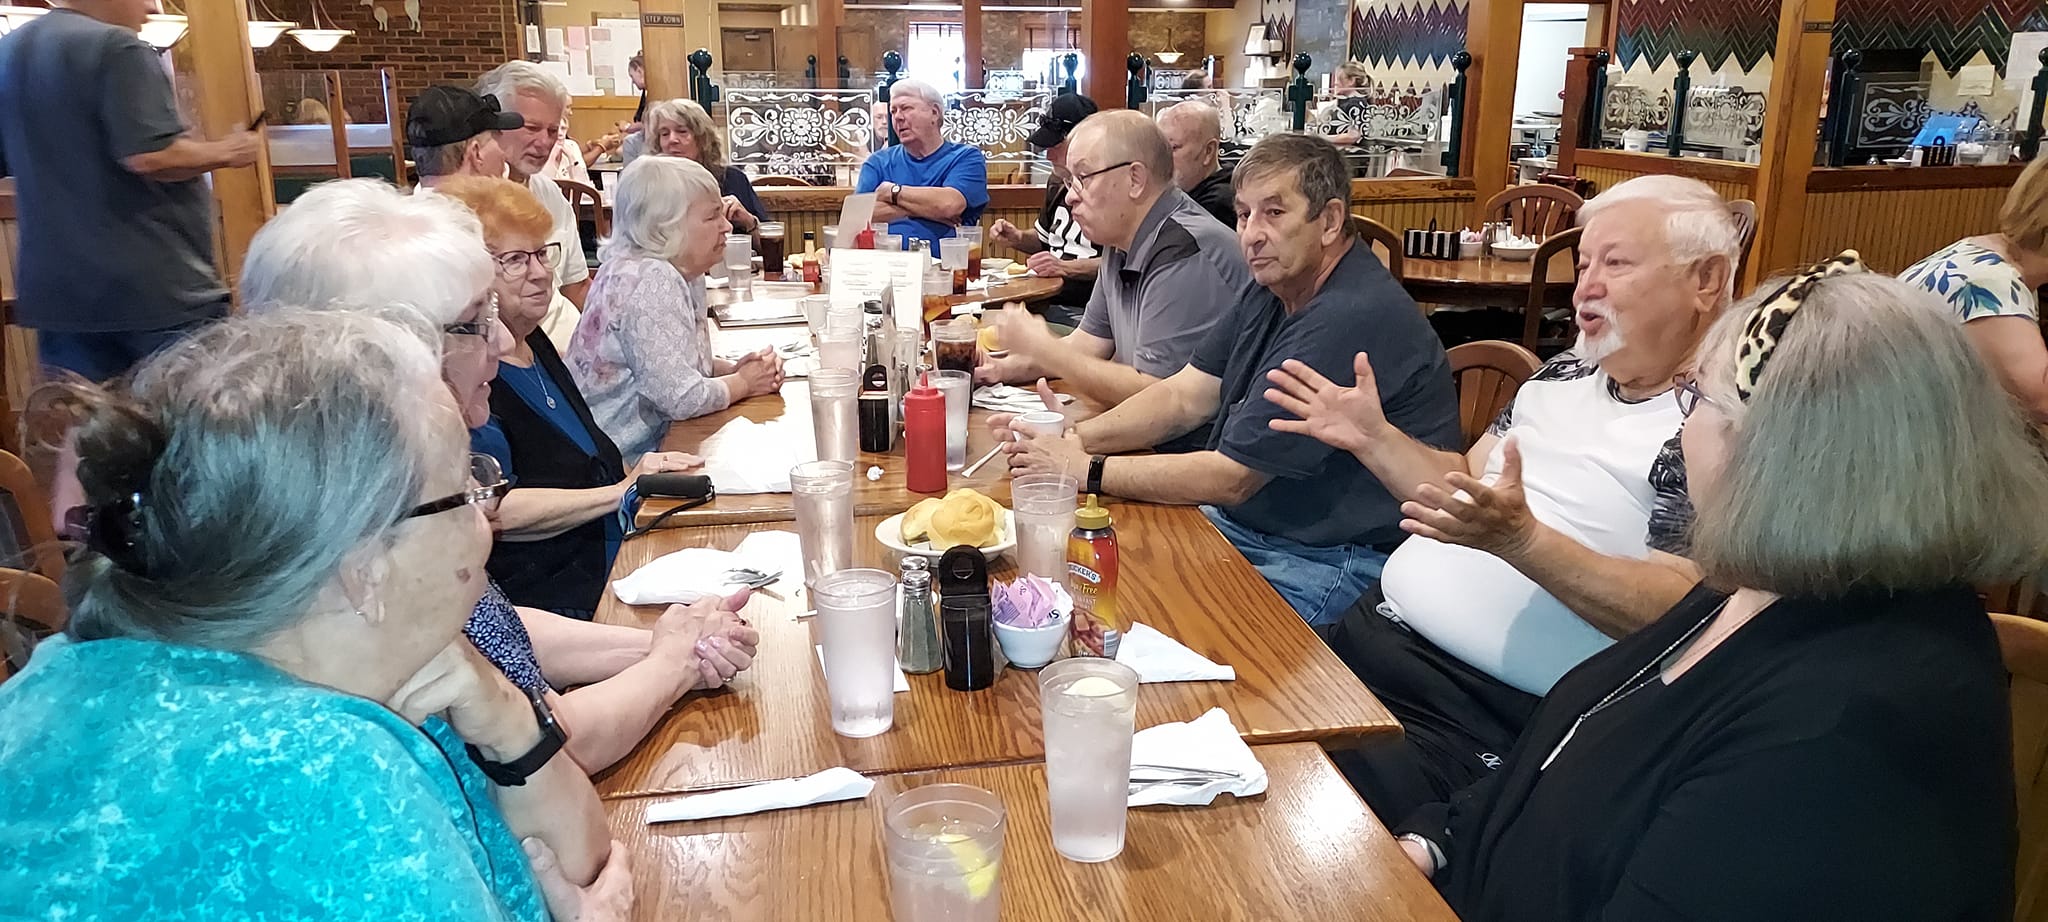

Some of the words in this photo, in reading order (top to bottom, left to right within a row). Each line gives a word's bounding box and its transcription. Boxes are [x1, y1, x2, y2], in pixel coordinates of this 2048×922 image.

[645, 15, 661, 24] STEP
[663, 15, 681, 24] DOWN
[1082, 583, 1098, 595] Free
